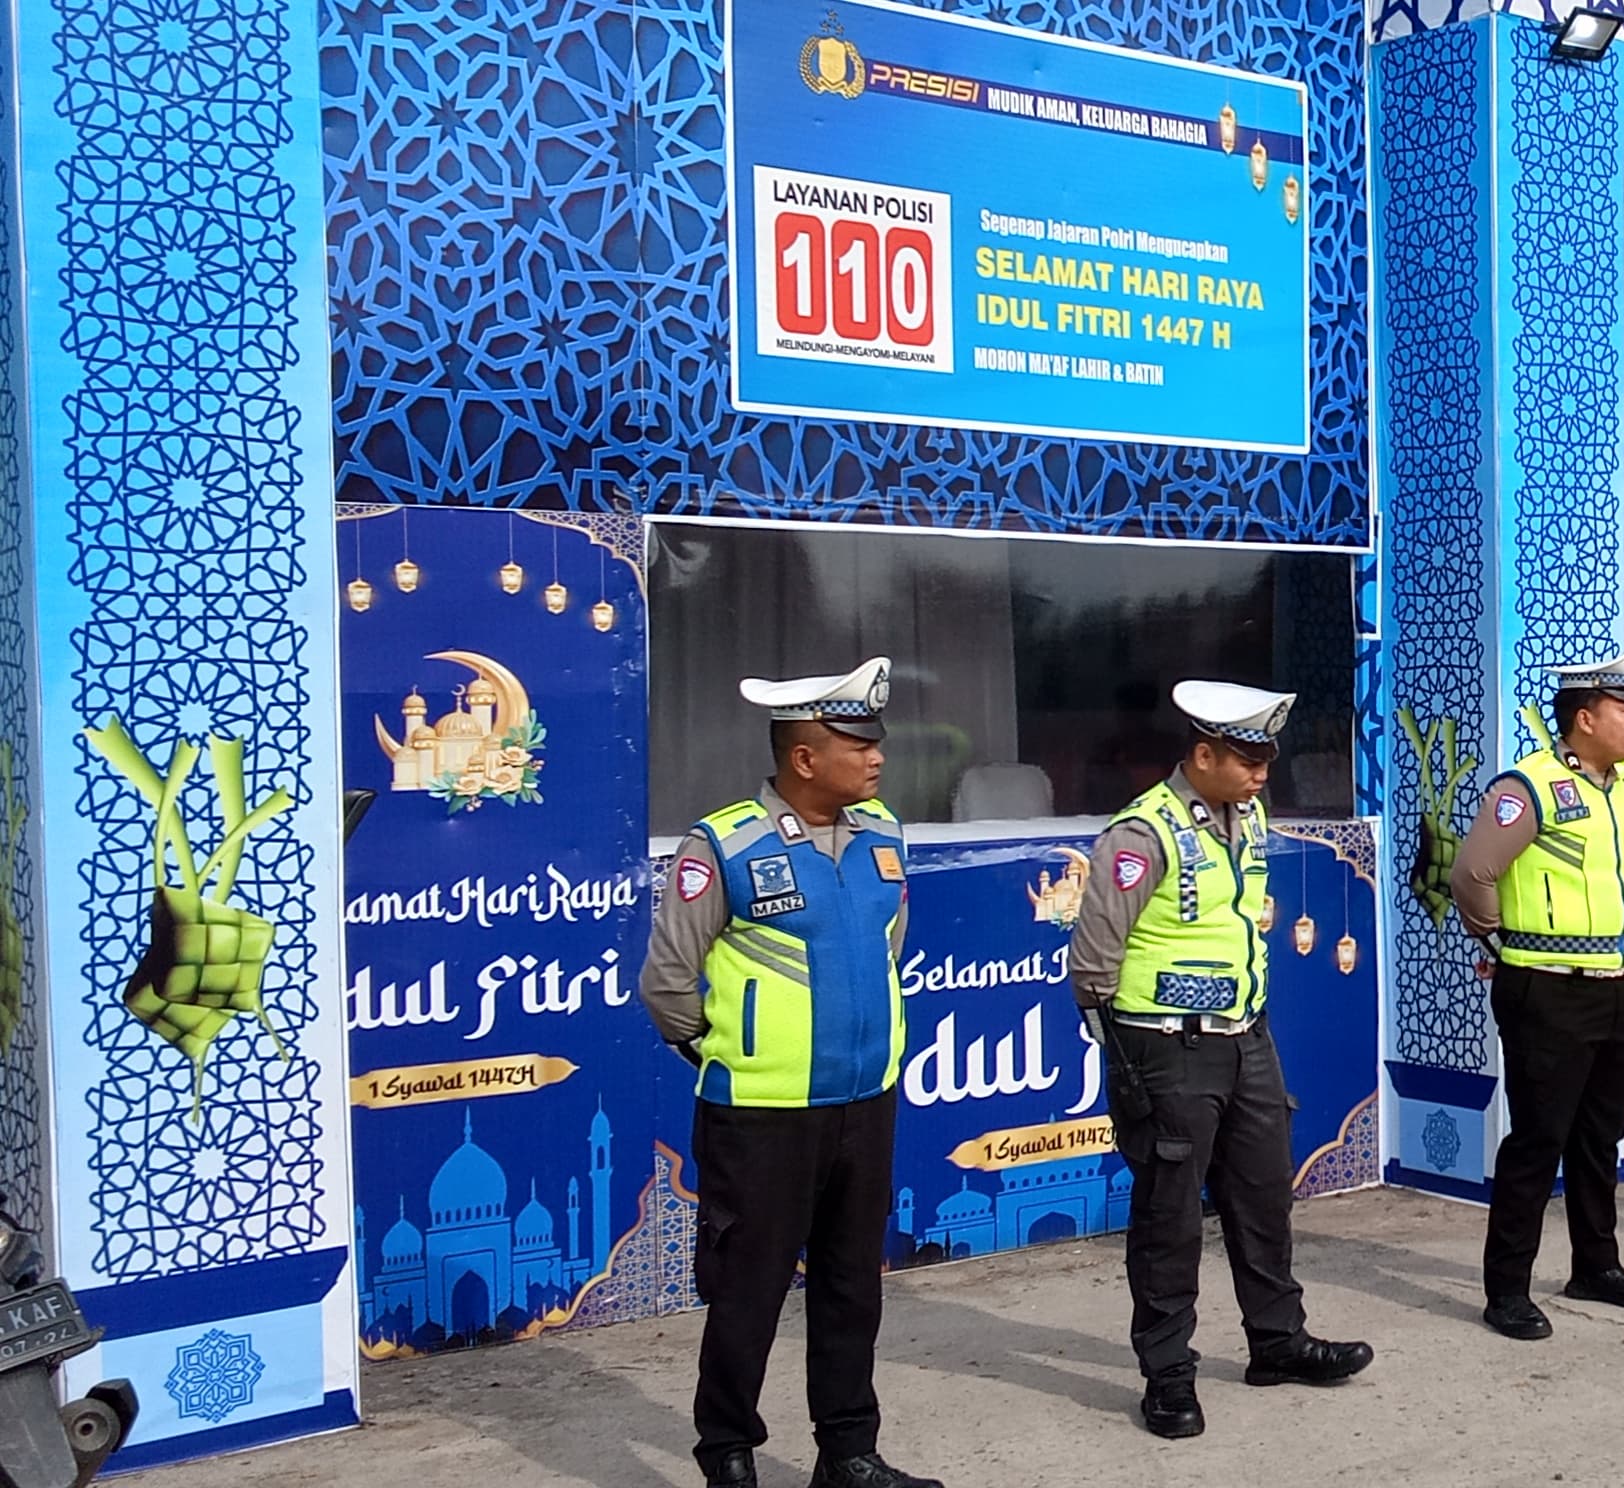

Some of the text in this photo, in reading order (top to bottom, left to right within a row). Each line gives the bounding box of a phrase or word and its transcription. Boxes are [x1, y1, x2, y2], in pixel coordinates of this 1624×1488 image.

[869, 64, 981, 104] PRESISI
[987, 87, 1208, 147] MUDIK AMAN, KELUARGA BAHAGIA
[773, 179, 934, 225] LAYANAN POLISI
[980, 208, 1229, 264] Segenap Jajaran Polri Mengucapkan
[781, 230, 930, 332] 110
[975, 246, 1265, 311] SELAMAT HARI RAYA
[976, 293, 1232, 350] IDUL FITRI 1447 H
[973, 346, 1165, 386] MOHON MA'AF LAHIR & BATIN
[445, 873, 543, 928] Hari
[534, 863, 638, 922] Raya
[754, 896, 803, 917] MANZ
[463, 948, 631, 1039] Fitri
[901, 949, 1047, 997] Selamat
[903, 1001, 1060, 1107] dul
[368, 1064, 539, 1101] 1 Syawal 1447H
[984, 1143, 992, 1162] 1
[994, 1133, 1064, 1162] Syawal
[7, 1295, 62, 1330] KAF
